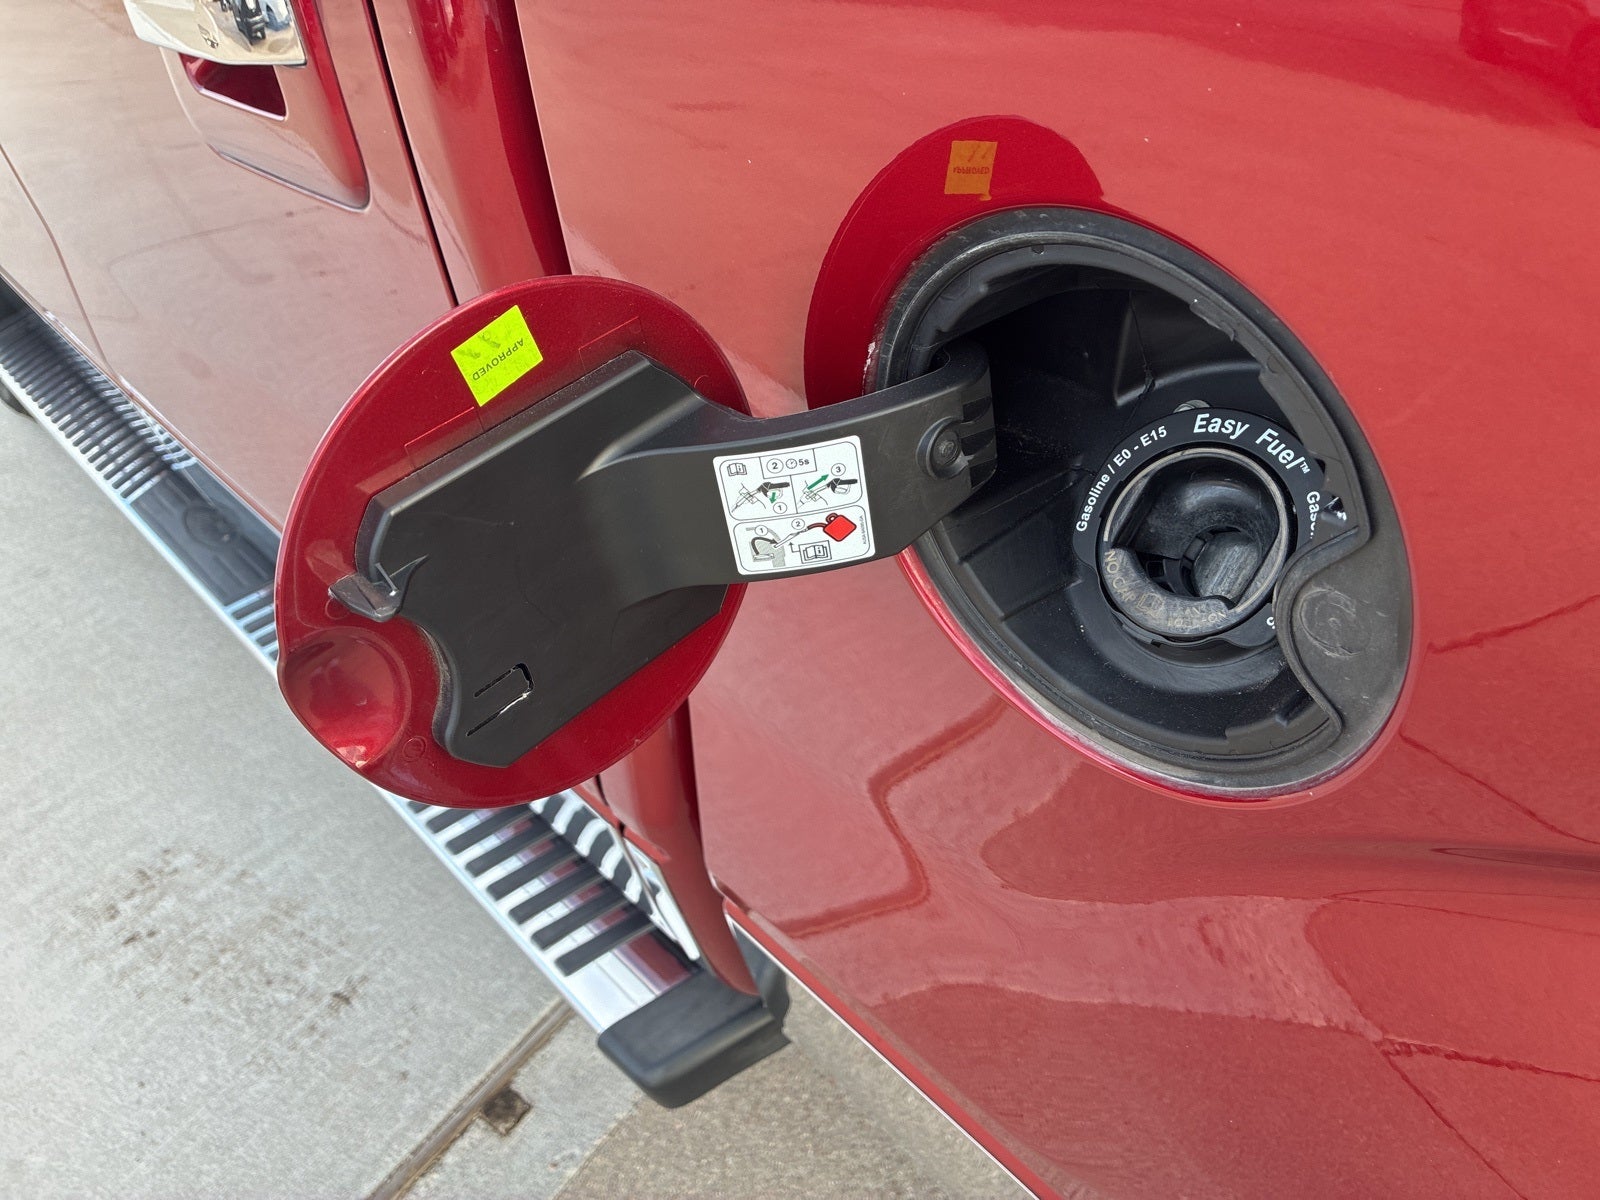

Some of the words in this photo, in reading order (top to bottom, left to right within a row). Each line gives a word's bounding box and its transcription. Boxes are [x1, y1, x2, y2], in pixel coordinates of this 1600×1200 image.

[472, 338, 525, 381] APPROVED
[1193, 413, 1250, 440] Easy
[798, 458, 810, 467] 5s
[1076, 475, 1111, 532] Gasoline
[1140, 425, 1168, 447] E15
[1104, 549, 1120, 574] NO
